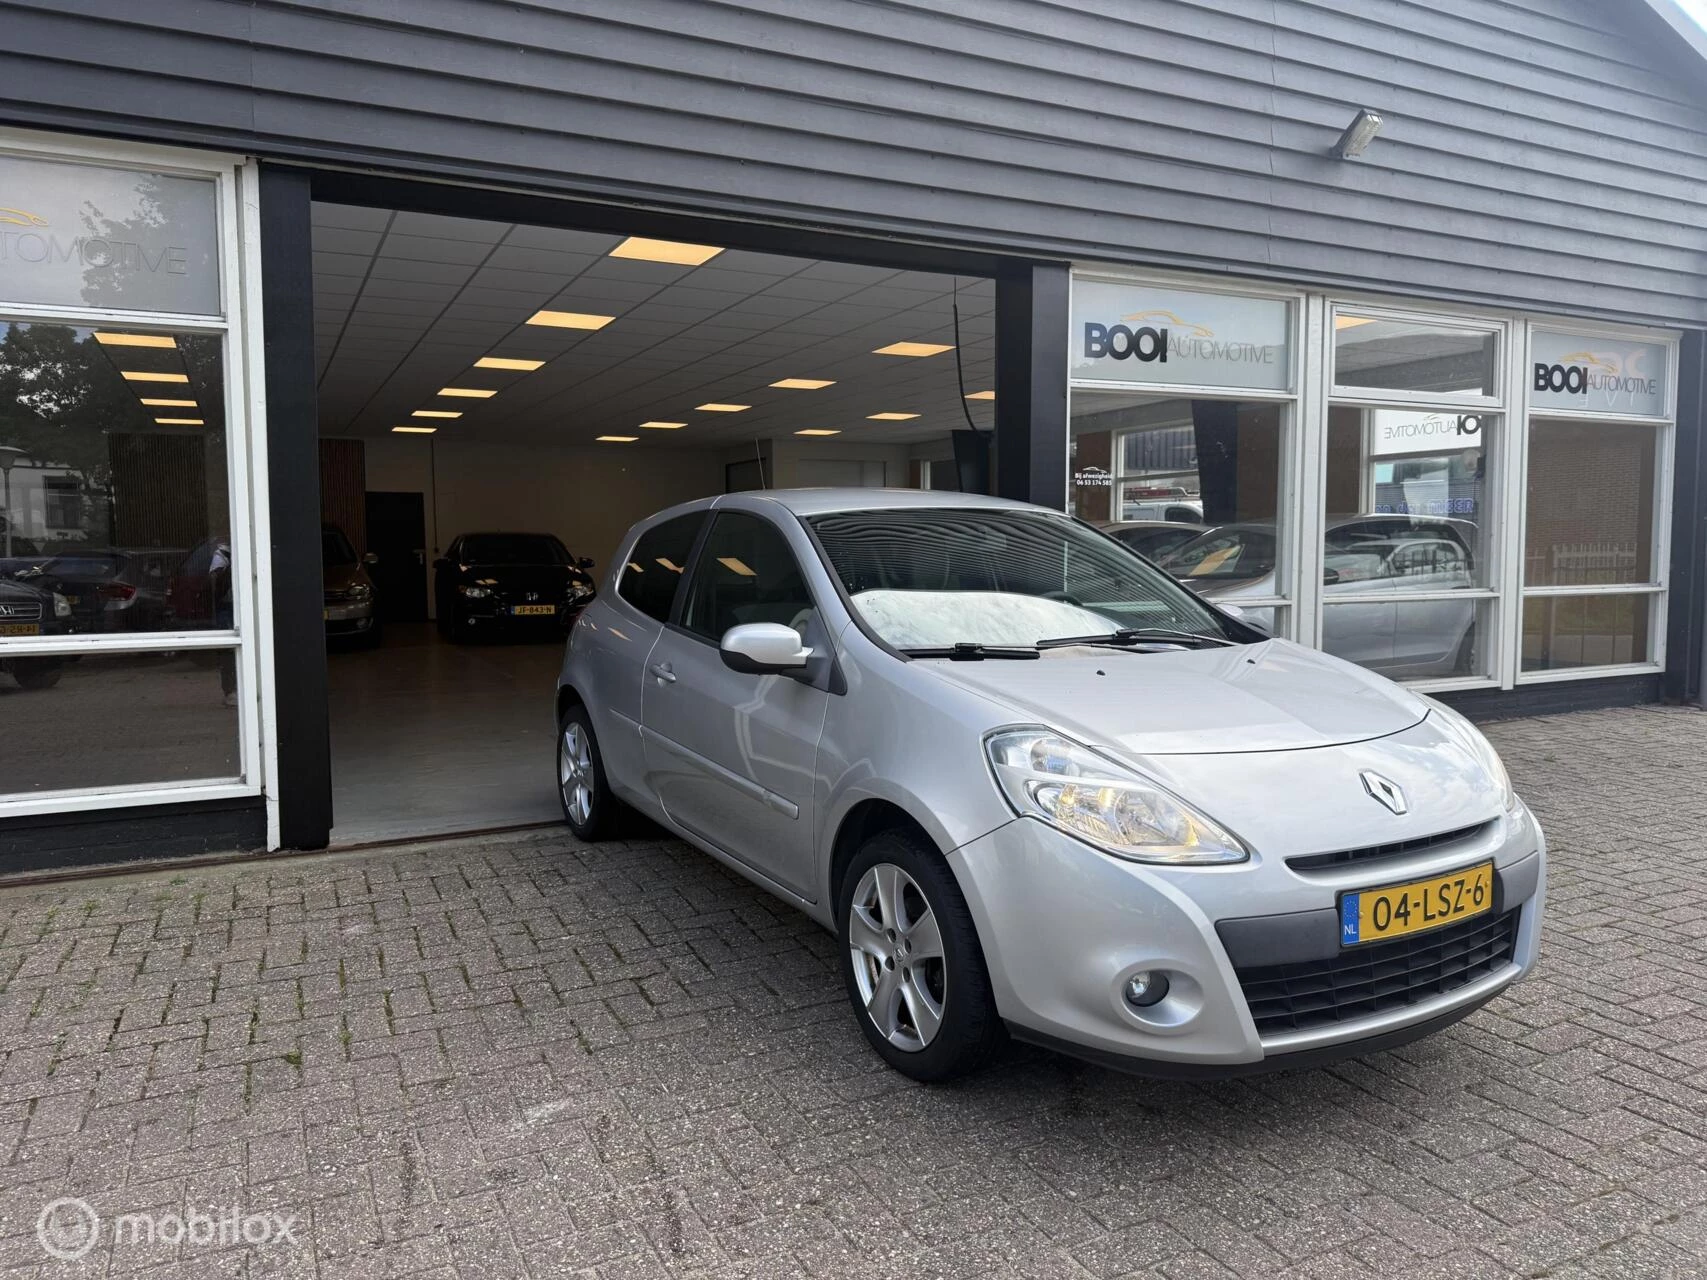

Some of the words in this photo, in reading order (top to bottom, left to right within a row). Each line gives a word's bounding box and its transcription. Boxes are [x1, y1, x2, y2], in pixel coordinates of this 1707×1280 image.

[1084, 322, 1168, 363] BOOI
[1168, 335, 1274, 364] AUTOMOTIVE
[1534, 362, 1588, 395] BOOI
[1588, 374, 1657, 395] AUTOMOTIVE
[1373, 873, 1484, 931] 04-LSZ-6
[1344, 924, 1357, 935] NL
